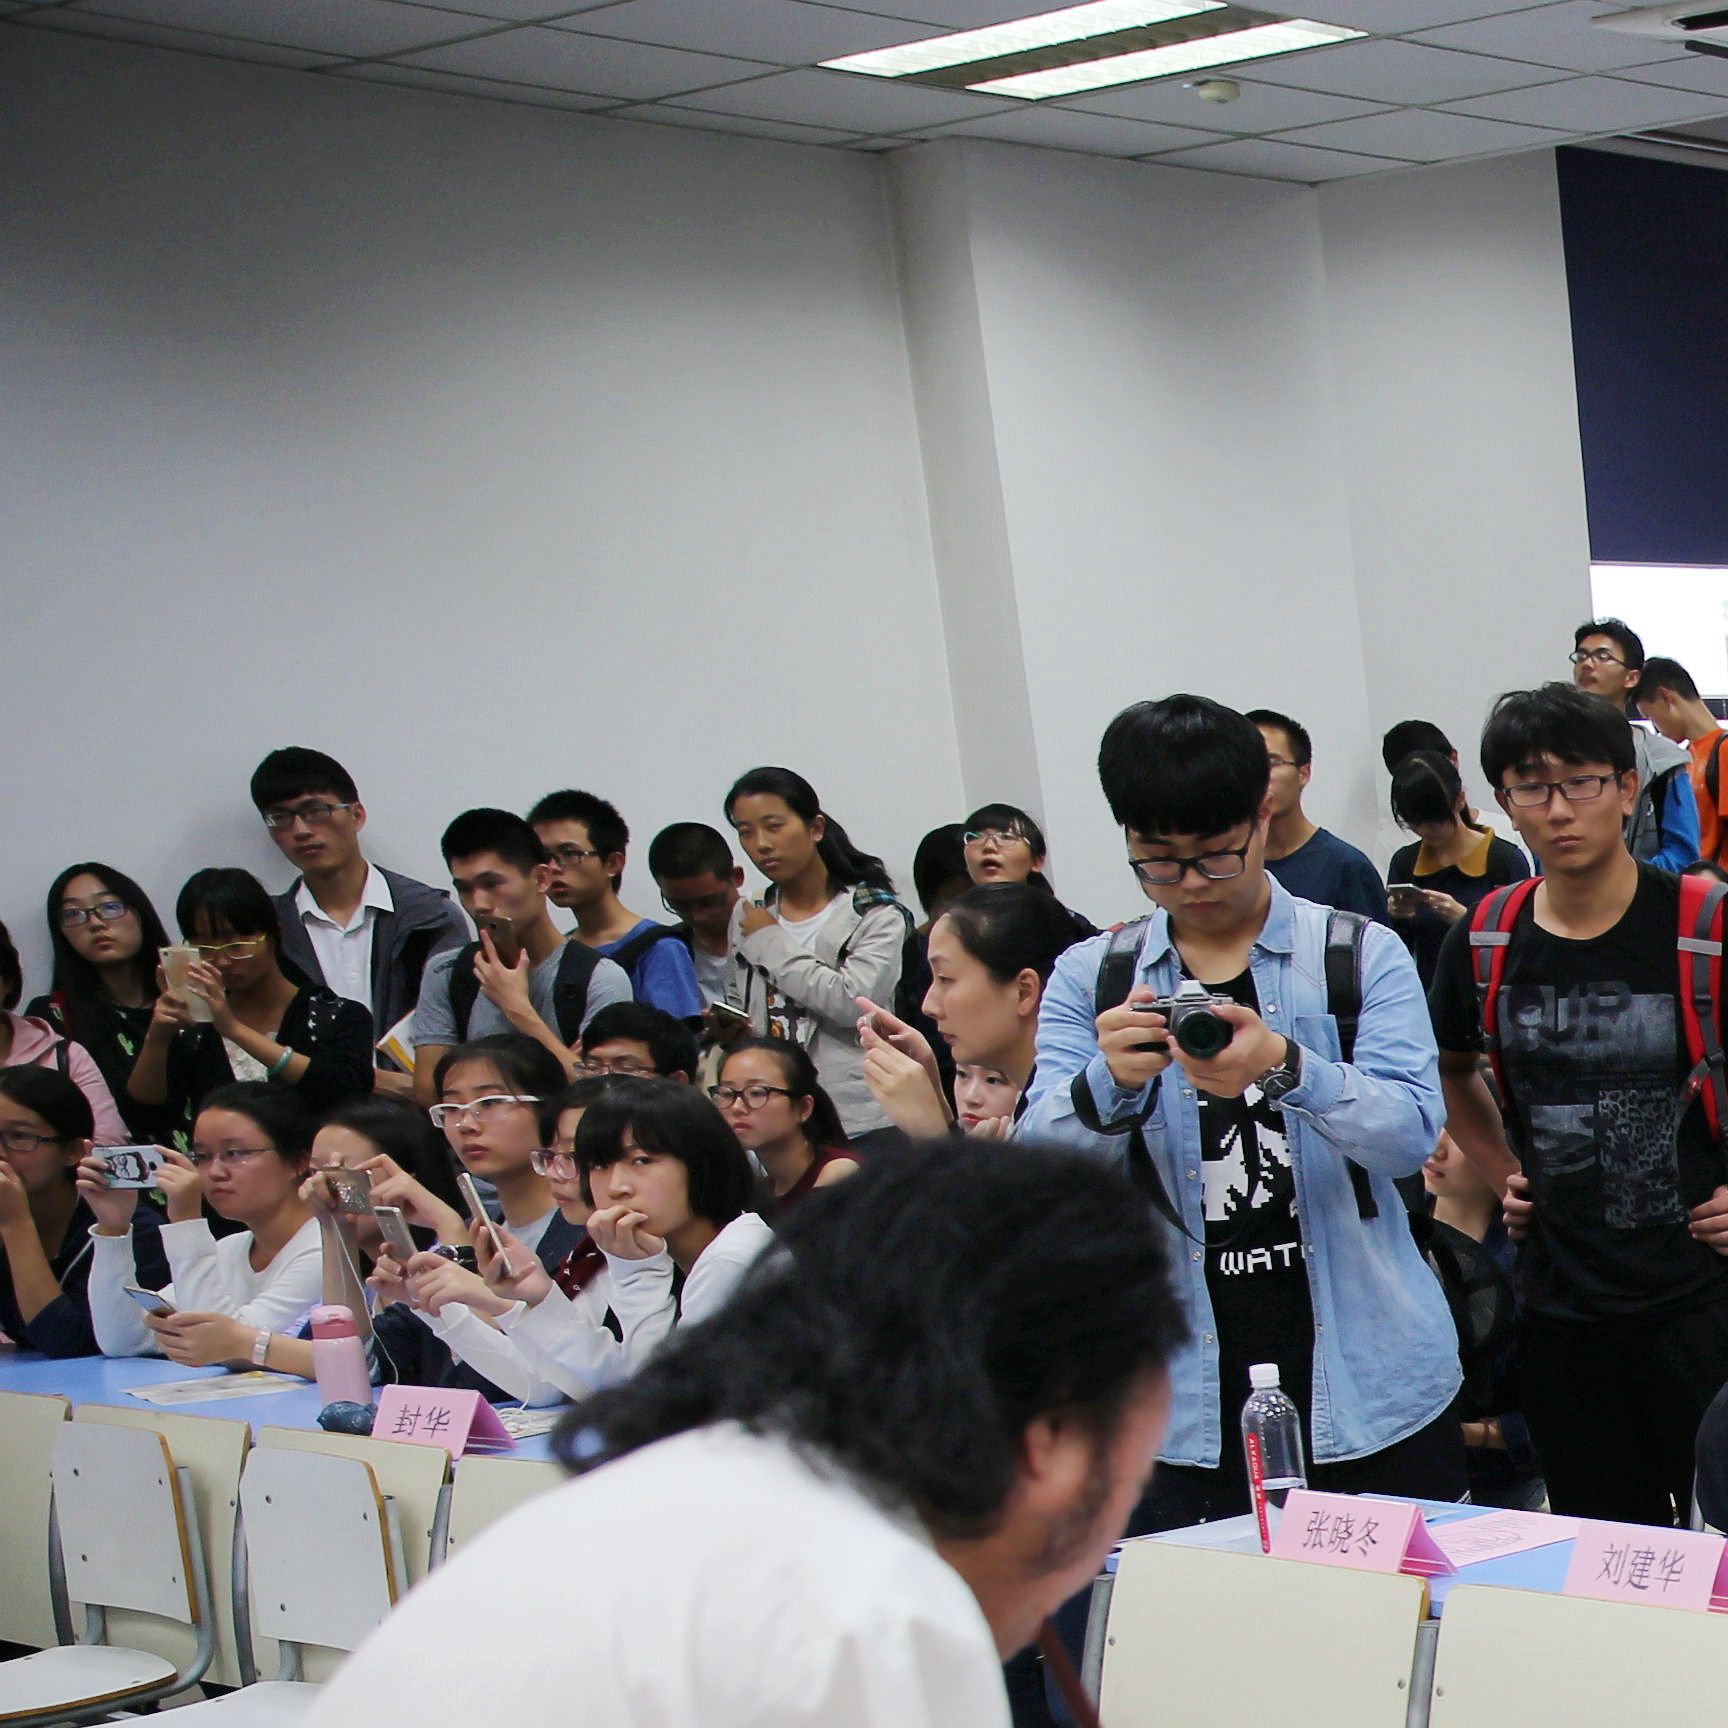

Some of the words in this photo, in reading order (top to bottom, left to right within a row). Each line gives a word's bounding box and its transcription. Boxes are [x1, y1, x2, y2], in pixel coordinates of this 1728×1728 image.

[391, 1403, 451, 1438] 封华
[1302, 1510, 1380, 1557] 张晓冬
[1596, 1542, 1686, 1592] 刘建华
